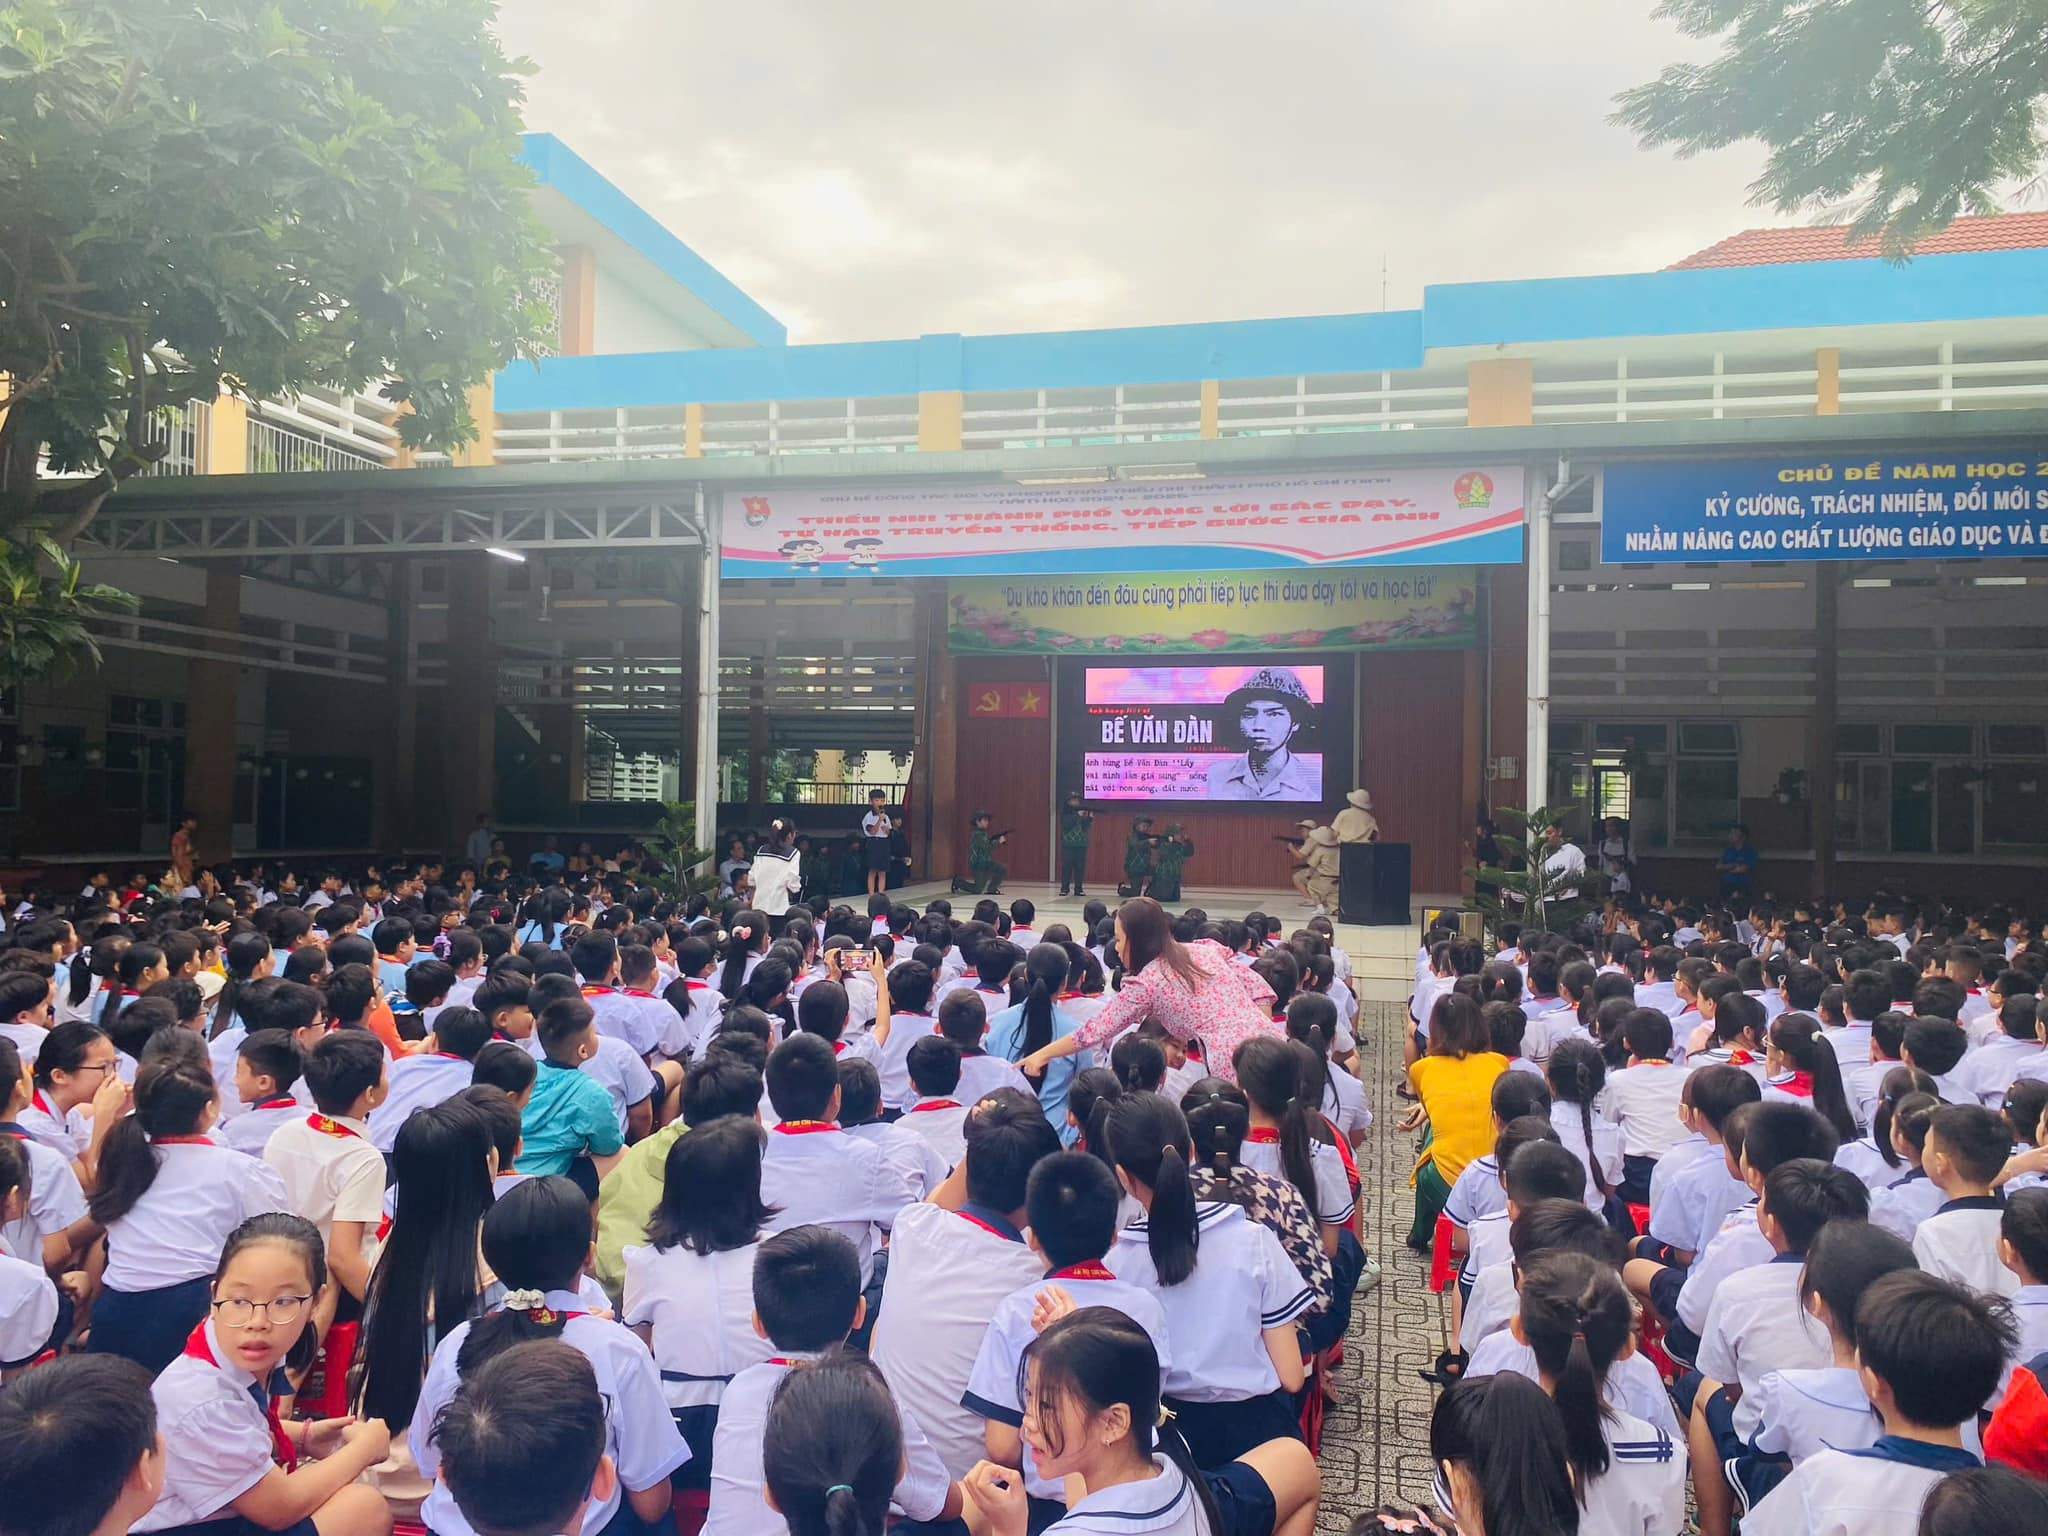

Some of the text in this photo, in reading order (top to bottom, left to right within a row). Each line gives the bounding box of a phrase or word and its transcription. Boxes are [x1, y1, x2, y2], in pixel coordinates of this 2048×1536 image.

[1777, 463, 1833, 483] CHỦ
[1844, 461, 1881, 481] ĐỀ
[1893, 462, 1957, 480] NĂM
[1966, 462, 2027, 480] HỌC
[1705, 490, 1730, 517] KỶ
[1735, 492, 1806, 519] CƯƠNG,
[1811, 489, 1875, 514] TRÁCH
[1880, 488, 1949, 518] NHIỆM,
[1953, 481, 1988, 512] ĐỔI
[1993, 484, 2031, 511] MỚI
[887, 513, 937, 523] NHI
[1371, 511, 1440, 522] ANH
[1625, 524, 1678, 551] NHẰM
[1682, 527, 1734, 550] NÂNG
[1738, 530, 1777, 549] CAO
[1781, 521, 1833, 549] CHẤT
[1838, 523, 1903, 553] LƯỢNG
[1908, 520, 1956, 546] GIÁO
[1961, 524, 2002, 551] DỤC
[2007, 519, 2035, 545] VÀ
[1178, 577, 1207, 608] phải
[1263, 579, 1279, 601] thi
[1101, 714, 1213, 743] BẾ VĂN ĐÀN
